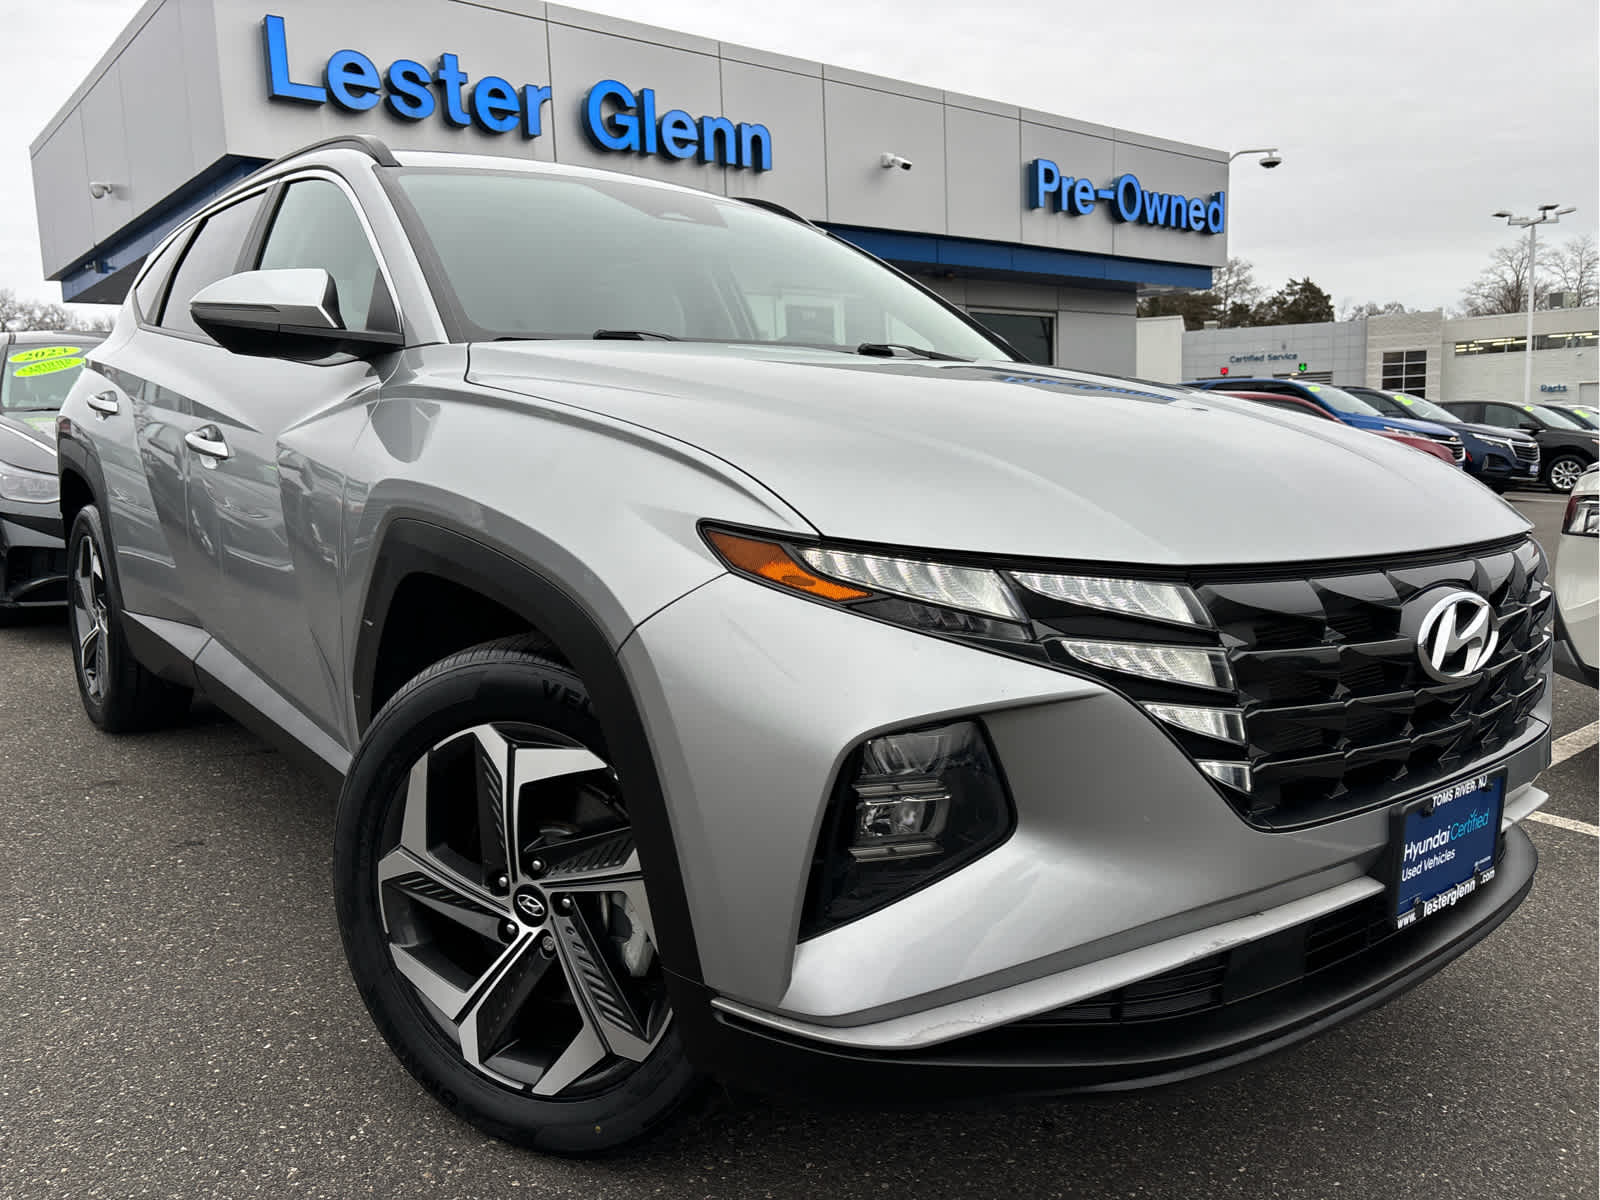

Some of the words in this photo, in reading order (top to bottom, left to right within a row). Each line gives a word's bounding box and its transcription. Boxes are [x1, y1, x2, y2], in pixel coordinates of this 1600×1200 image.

[263, 14, 552, 139] Lester
[582, 79, 773, 172] Glenn
[1029, 158, 1225, 235] Pre-Owned
[1229, 354, 1265, 363] Certified
[1267, 353, 1297, 361] Service
[1540, 384, 1568, 392] Parts
[1432, 790, 1453, 808] TOMS
[1478, 775, 1487, 788] NJ
[1404, 826, 1450, 861] Hyundai
[1451, 808, 1489, 840] Certified
[1401, 862, 1423, 882] Used
[1423, 848, 1456, 872] Vehicles
